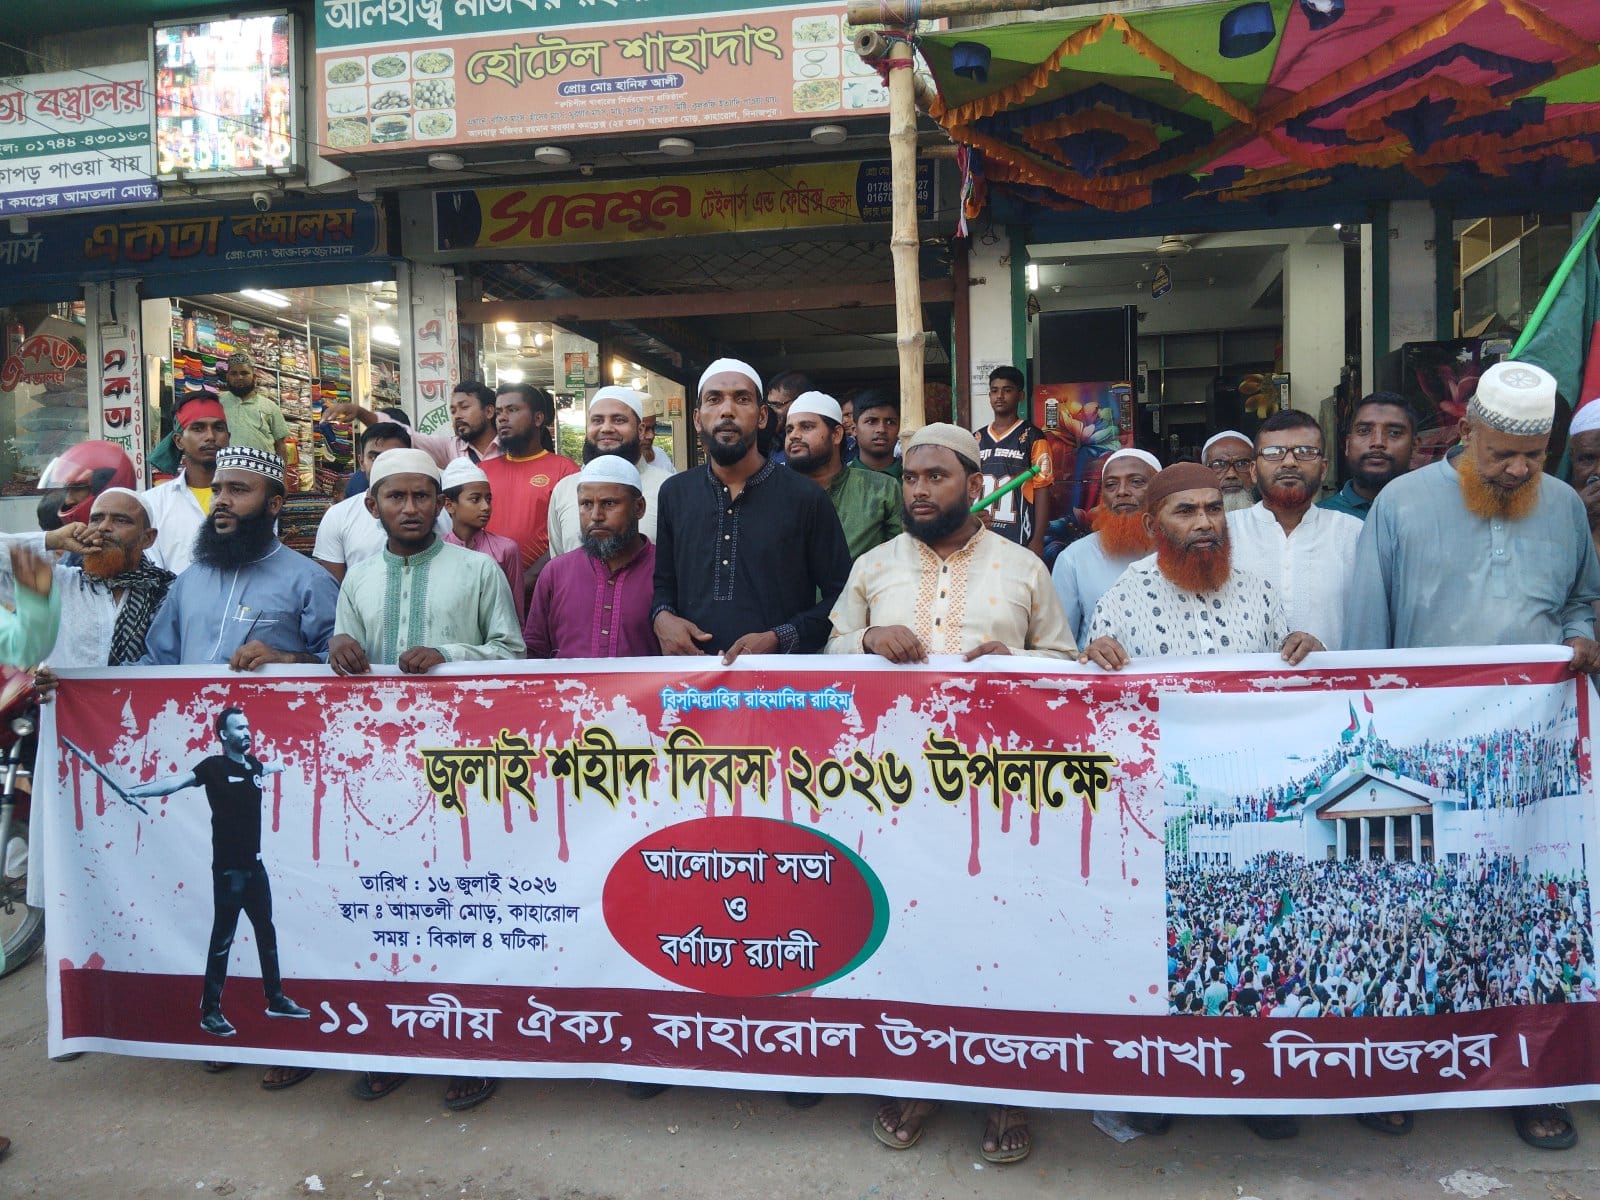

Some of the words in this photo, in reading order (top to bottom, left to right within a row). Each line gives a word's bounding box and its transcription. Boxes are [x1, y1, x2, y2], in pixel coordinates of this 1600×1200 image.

[466, 33, 607, 88] হোটেল
[615, 23, 783, 75] শাহাদাৎ
[562, 83, 586, 95] প্রোঃ
[590, 81, 612, 93] মোঃ
[615, 77, 646, 91] হানিফ
[651, 74, 677, 88] আলী
[0, 91, 26, 121] তা
[34, 80, 144, 121] বস্ত্রালয়
[48, 158, 103, 179] পাওয়া
[108, 155, 143, 173] যায়
[8, 193, 59, 208] কমপ্লেক্স
[62, 187, 117, 204] আমতলা
[490, 185, 692, 242] সানমুন
[701, 183, 749, 220] টেইলার্স
[85, 215, 224, 263] একতা
[744, 686, 806, 710] রাহমানির
[810, 686, 852, 711] রাহিম
[420, 730, 537, 816] জুলাই
[545, 727, 656, 811] শহীদ
[664, 726, 774, 804] দিবস
[787, 746, 913, 815] ২০২৬
[922, 730, 1116, 813] উপলক্ষে
[640, 848, 768, 883] আলোচনা
[774, 850, 835, 885] সভা
[360, 871, 408, 893] তারিখ
[428, 876, 450, 893] ১৬
[455, 872, 502, 897] জুলাই
[508, 876, 557, 895] ২০২৬
[338, 902, 369, 923] স্থান
[388, 898, 453, 921] আমতলী
[459, 903, 503, 924] মোড়,
[508, 903, 580, 924] কাহারোল
[723, 896, 748, 922] ও
[372, 930, 409, 947] সময়
[427, 926, 477, 949] বিকাল
[482, 932, 492, 949] ৪
[500, 928, 547, 951] ঘটিকা
[657, 926, 737, 967] বর্ণাঢ্য
[319, 1001, 369, 1035] ১১
[386, 993, 502, 1042] দলীয়
[516, 995, 633, 1052] ঐক্য,
[648, 1012, 865, 1058] কাহারোল
[876, 1013, 1094, 1075] উপজেলা
[1105, 1035, 1246, 1086] শাখা,
[1262, 1029, 1498, 1080] দিনাজপুর
